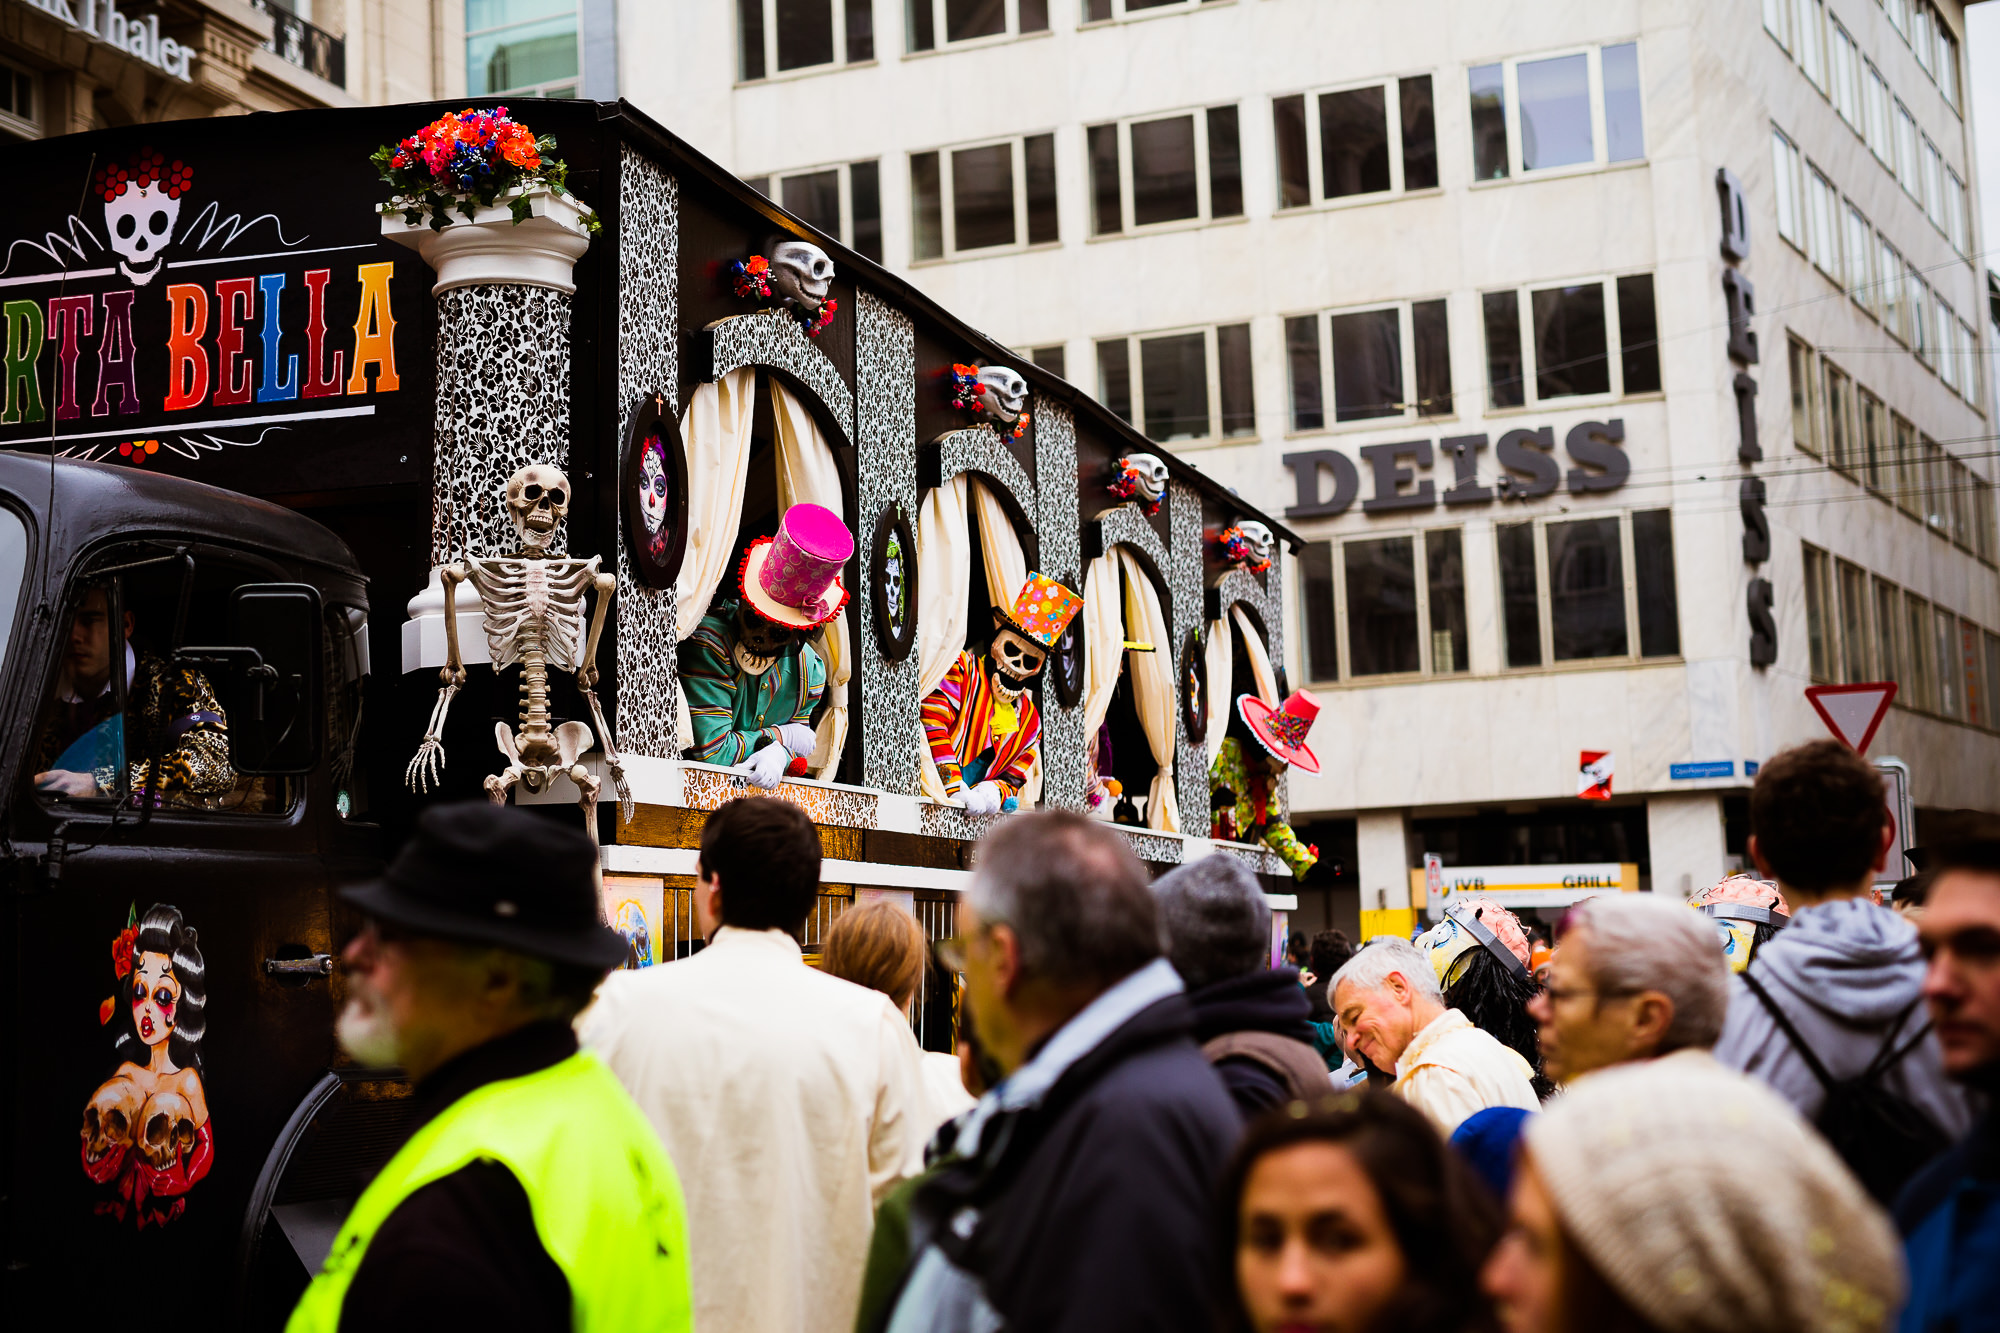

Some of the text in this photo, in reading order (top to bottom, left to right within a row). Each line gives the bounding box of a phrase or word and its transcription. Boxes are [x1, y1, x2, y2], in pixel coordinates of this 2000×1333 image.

[0, 261, 400, 425] RTA BELLA
[1282, 418, 1631, 520] DEISS
[1716, 167, 1778, 669] DEISS
[1561, 873, 1617, 889] GRILL
